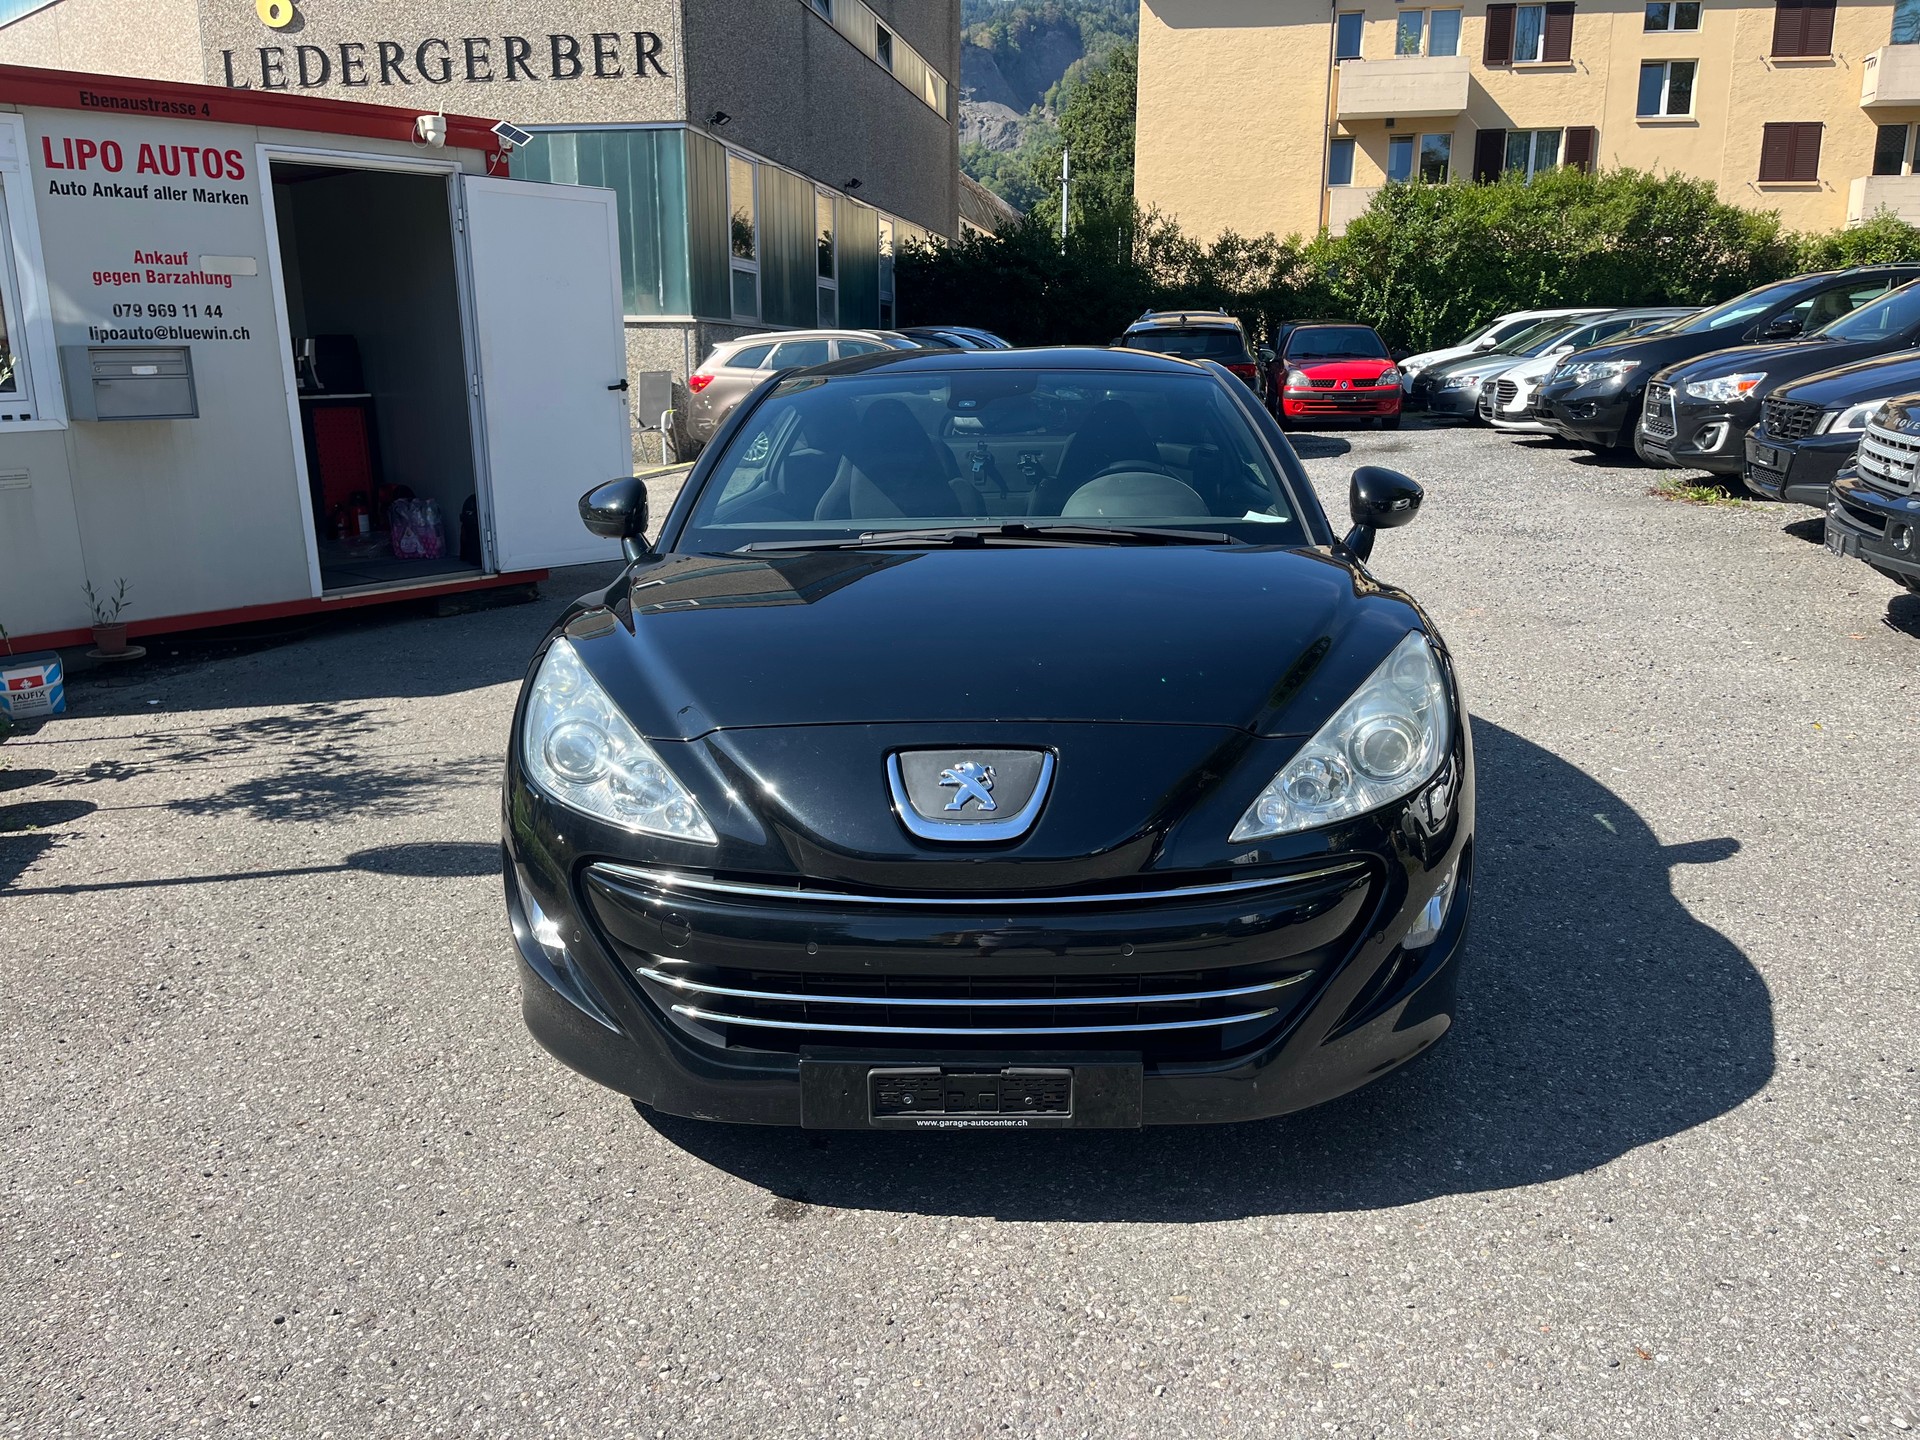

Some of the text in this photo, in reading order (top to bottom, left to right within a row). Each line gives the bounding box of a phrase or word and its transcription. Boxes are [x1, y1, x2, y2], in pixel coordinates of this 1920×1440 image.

[219, 31, 672, 90] LEDERGERBER
[79, 91, 211, 117] Ebenaustrasse 4
[41, 136, 245, 180] LIPO AUTOS
[49, 180, 249, 205] Auto Ankauf aller Marken
[133, 250, 189, 266] Ankauf
[92, 270, 233, 289] gegen Barzahlung
[112, 303, 223, 318] 079 969 11 44
[88, 326, 251, 344] lipoauto@bluewin.ch
[11, 690, 46, 701] TAUFIX
[916, 1119, 1028, 1127] www.garage-autocenter.ch
